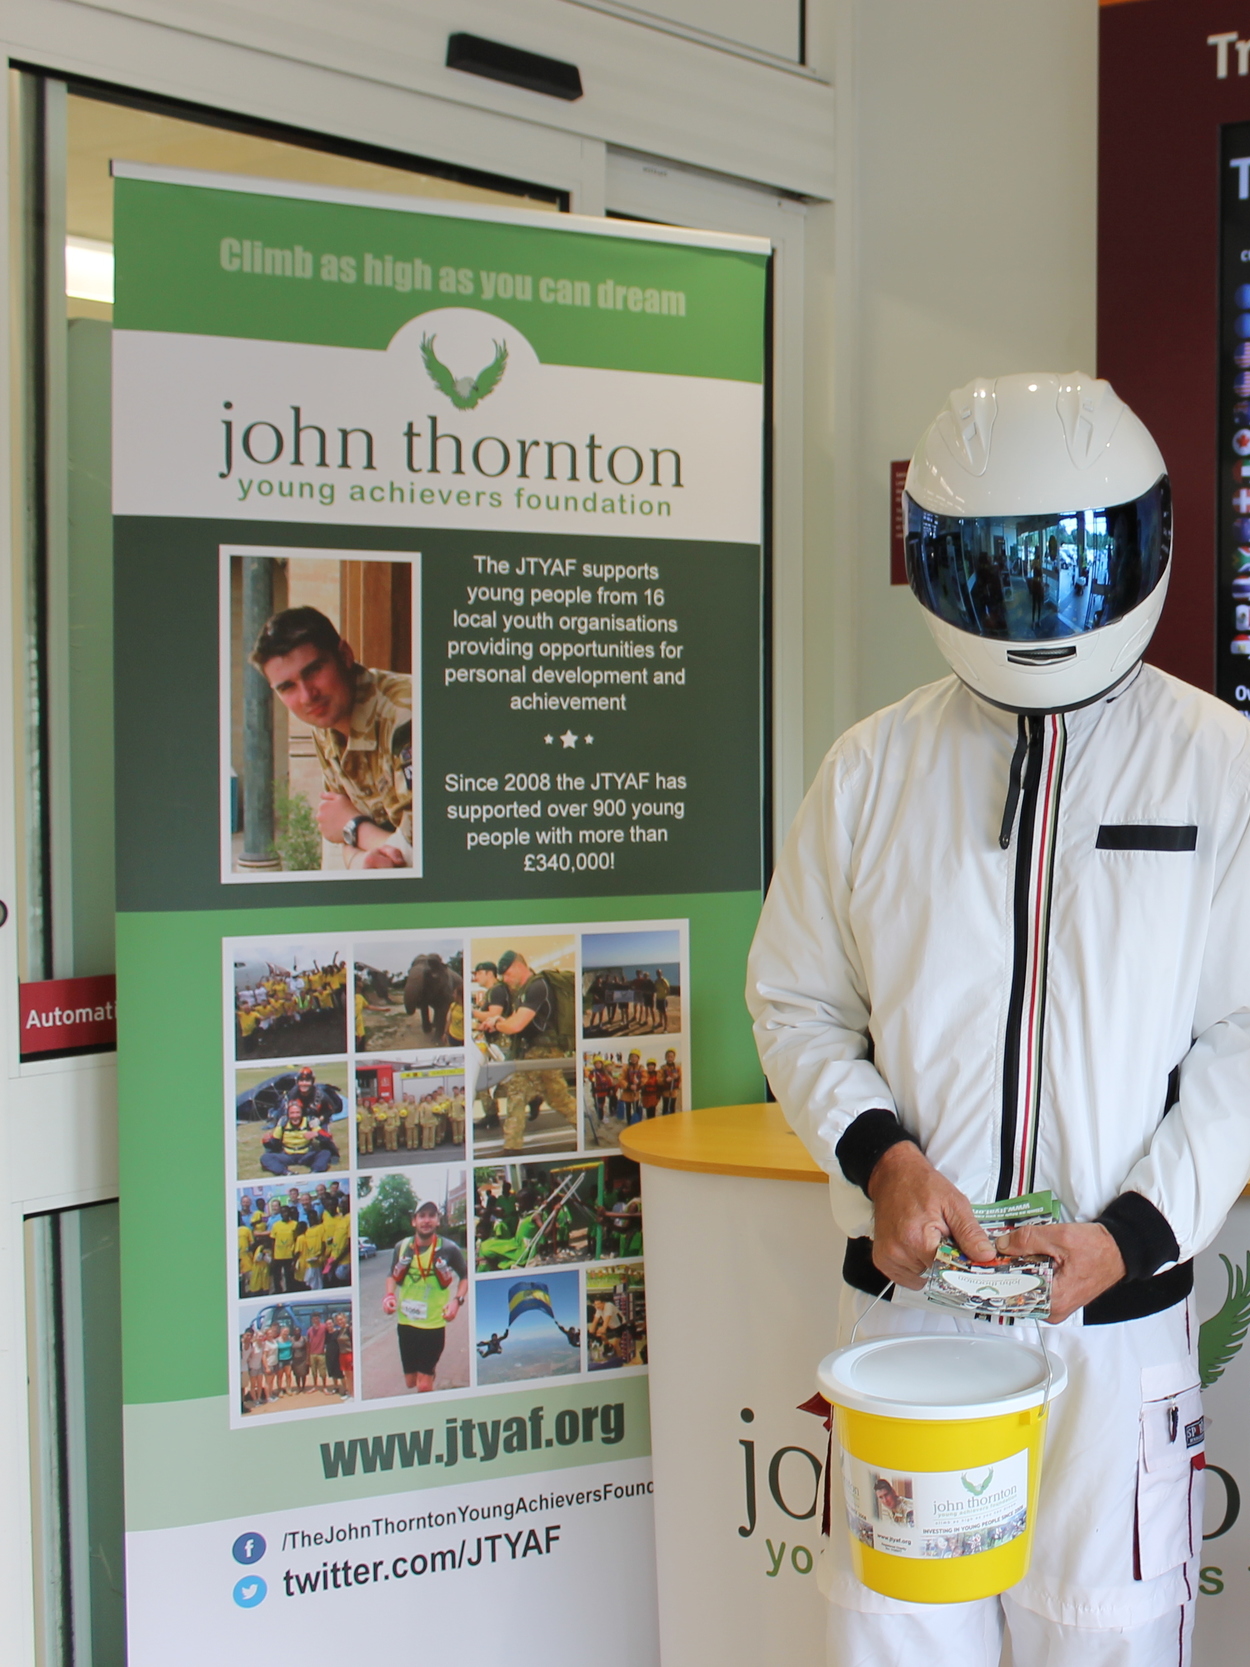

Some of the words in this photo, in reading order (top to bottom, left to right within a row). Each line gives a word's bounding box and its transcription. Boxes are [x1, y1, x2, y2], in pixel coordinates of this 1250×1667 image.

[220, 238, 312, 280] Climb
[320, 252, 356, 283] as
[364, 254, 432, 292] high
[439, 263, 473, 295] as
[480, 269, 532, 302] you
[540, 275, 590, 307] can
[598, 279, 686, 317] dream
[219, 401, 377, 479] john
[403, 415, 683, 487] thornton
[237, 476, 335, 506] young
[350, 481, 502, 508] achievers
[514, 487, 671, 516] foundation
[473, 555, 510, 574] The
[516, 557, 577, 576] JTYAF
[582, 562, 659, 582] supports
[467, 586, 523, 606] young
[531, 586, 591, 606] people
[597, 587, 637, 605] from
[644, 588, 664, 606] 16
[453, 610, 496, 629] local
[503, 612, 553, 632] youth
[559, 614, 678, 634] organisations
[448, 638, 533, 659] providing
[540, 641, 654, 660] opportunities
[660, 642, 682, 658] for
[445, 666, 526, 686] personal
[532, 666, 648, 688] development
[653, 668, 685, 685] and
[510, 692, 626, 710] achievement
[445, 774, 498, 792] Since
[504, 774, 550, 791] 2008
[556, 774, 584, 790] the
[590, 772, 649, 790] JTYAF
[656, 772, 686, 789] has
[447, 800, 541, 822] supported
[547, 803, 587, 817] over
[593, 799, 626, 817] 900
[632, 801, 685, 820] young
[466, 828, 530, 850] people
[536, 826, 572, 844] with
[578, 828, 624, 843] more
[629, 826, 668, 842] than
[524, 852, 615, 872] £340,000!
[320, 1402, 625, 1479] www.jtyaf.org
[933, 1500, 964, 1514] john
[968, 1485, 1016, 1508] thornton
[982, 1517, 1000, 1526] PEOPLE
[1001, 1511, 1013, 1519] SINCE
[283, 1525, 561, 1597] twitter.com/JTYAF
